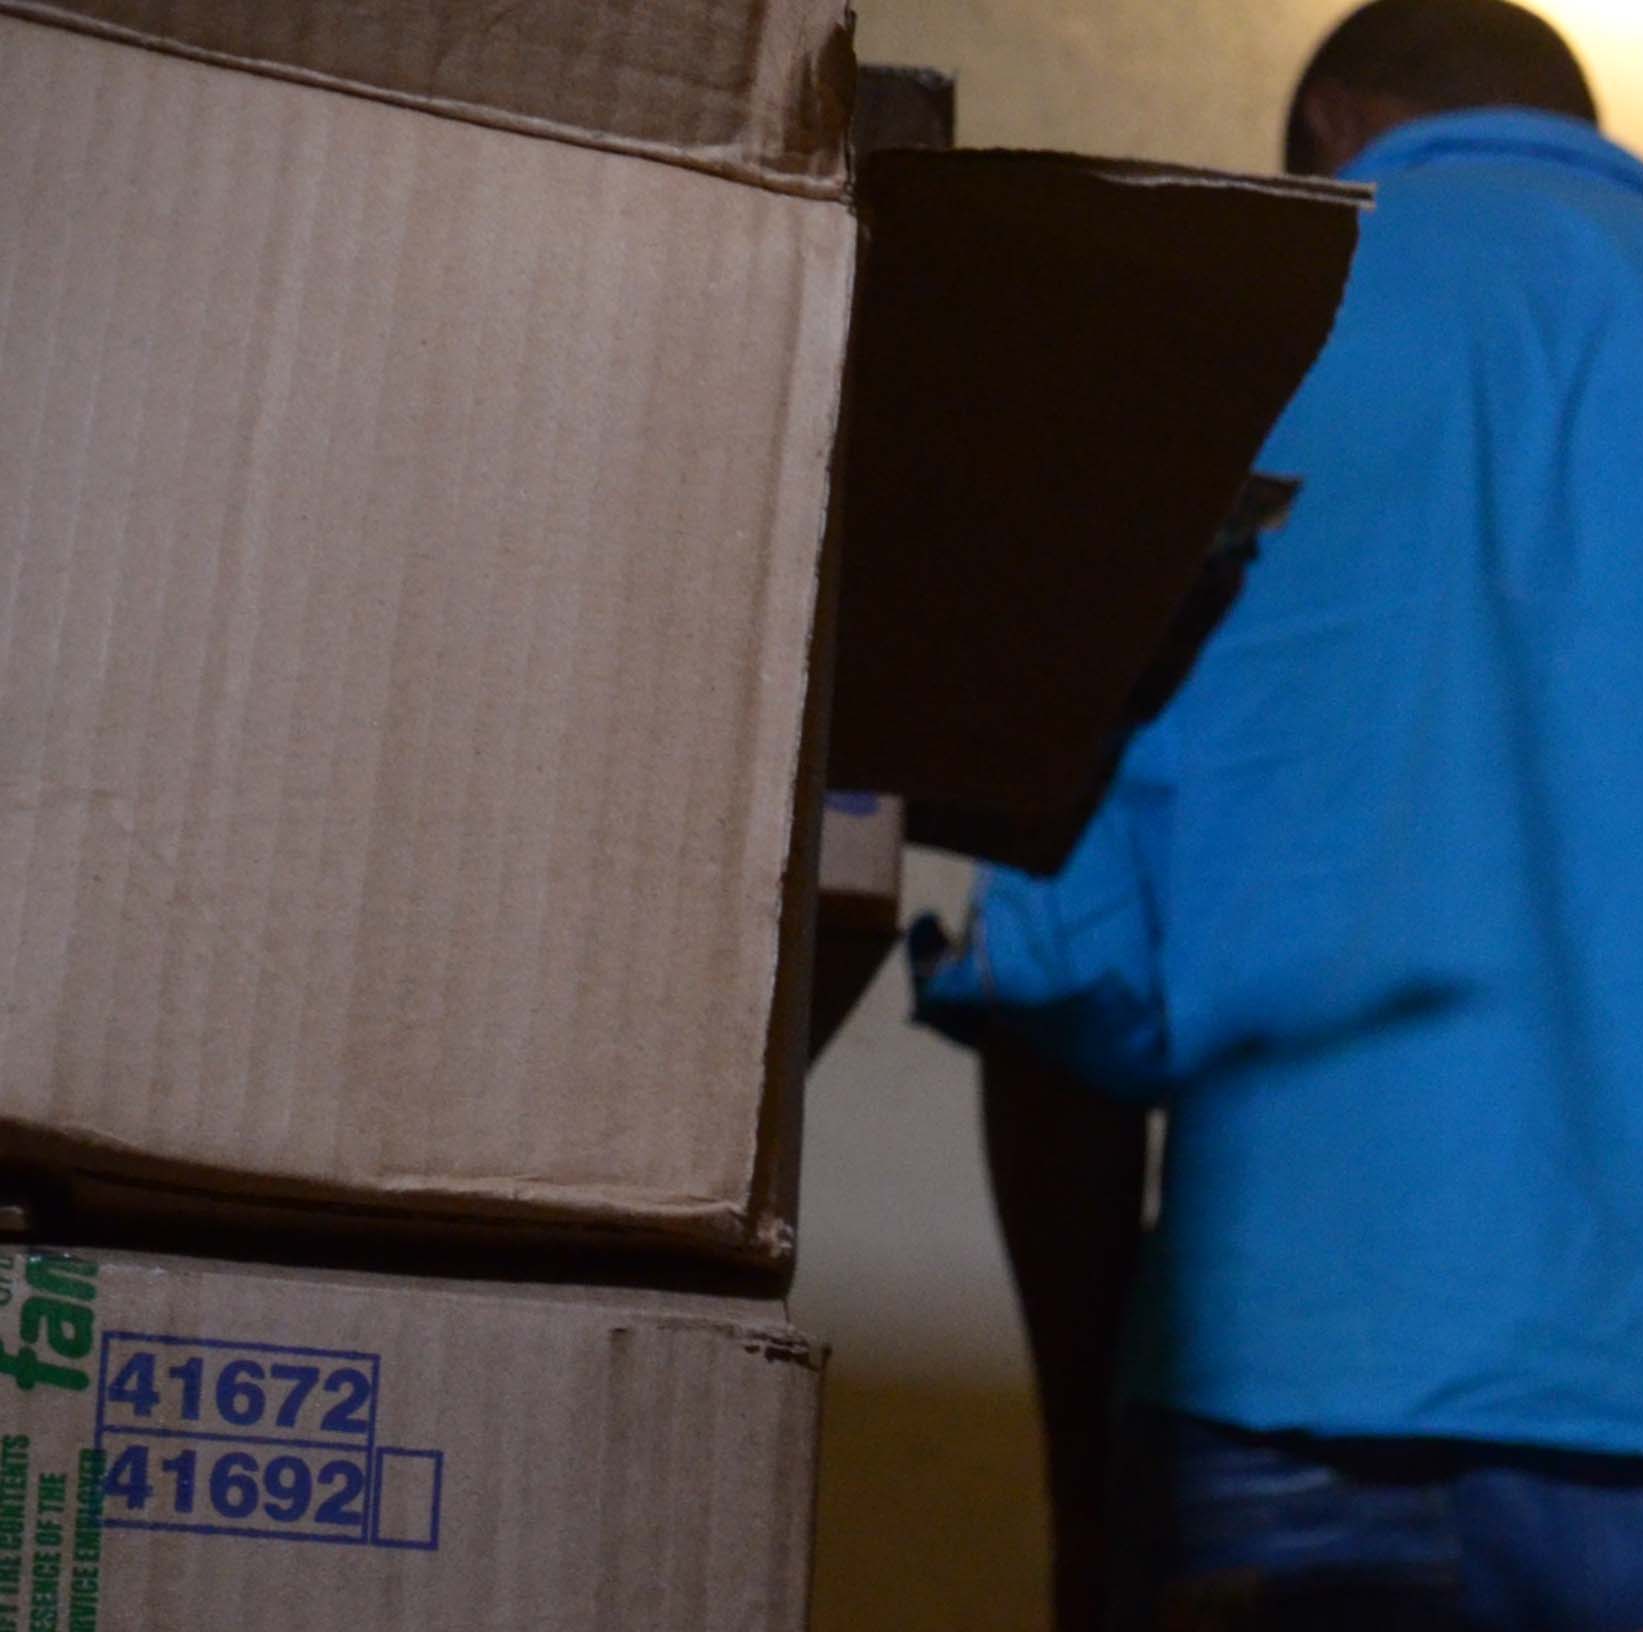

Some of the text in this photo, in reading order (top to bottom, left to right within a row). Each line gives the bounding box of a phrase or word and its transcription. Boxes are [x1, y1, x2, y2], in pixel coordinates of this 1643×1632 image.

[106, 1352, 370, 1434] 41672
[37, 1473, 67, 1516] THE
[102, 1445, 366, 1526] 41692
